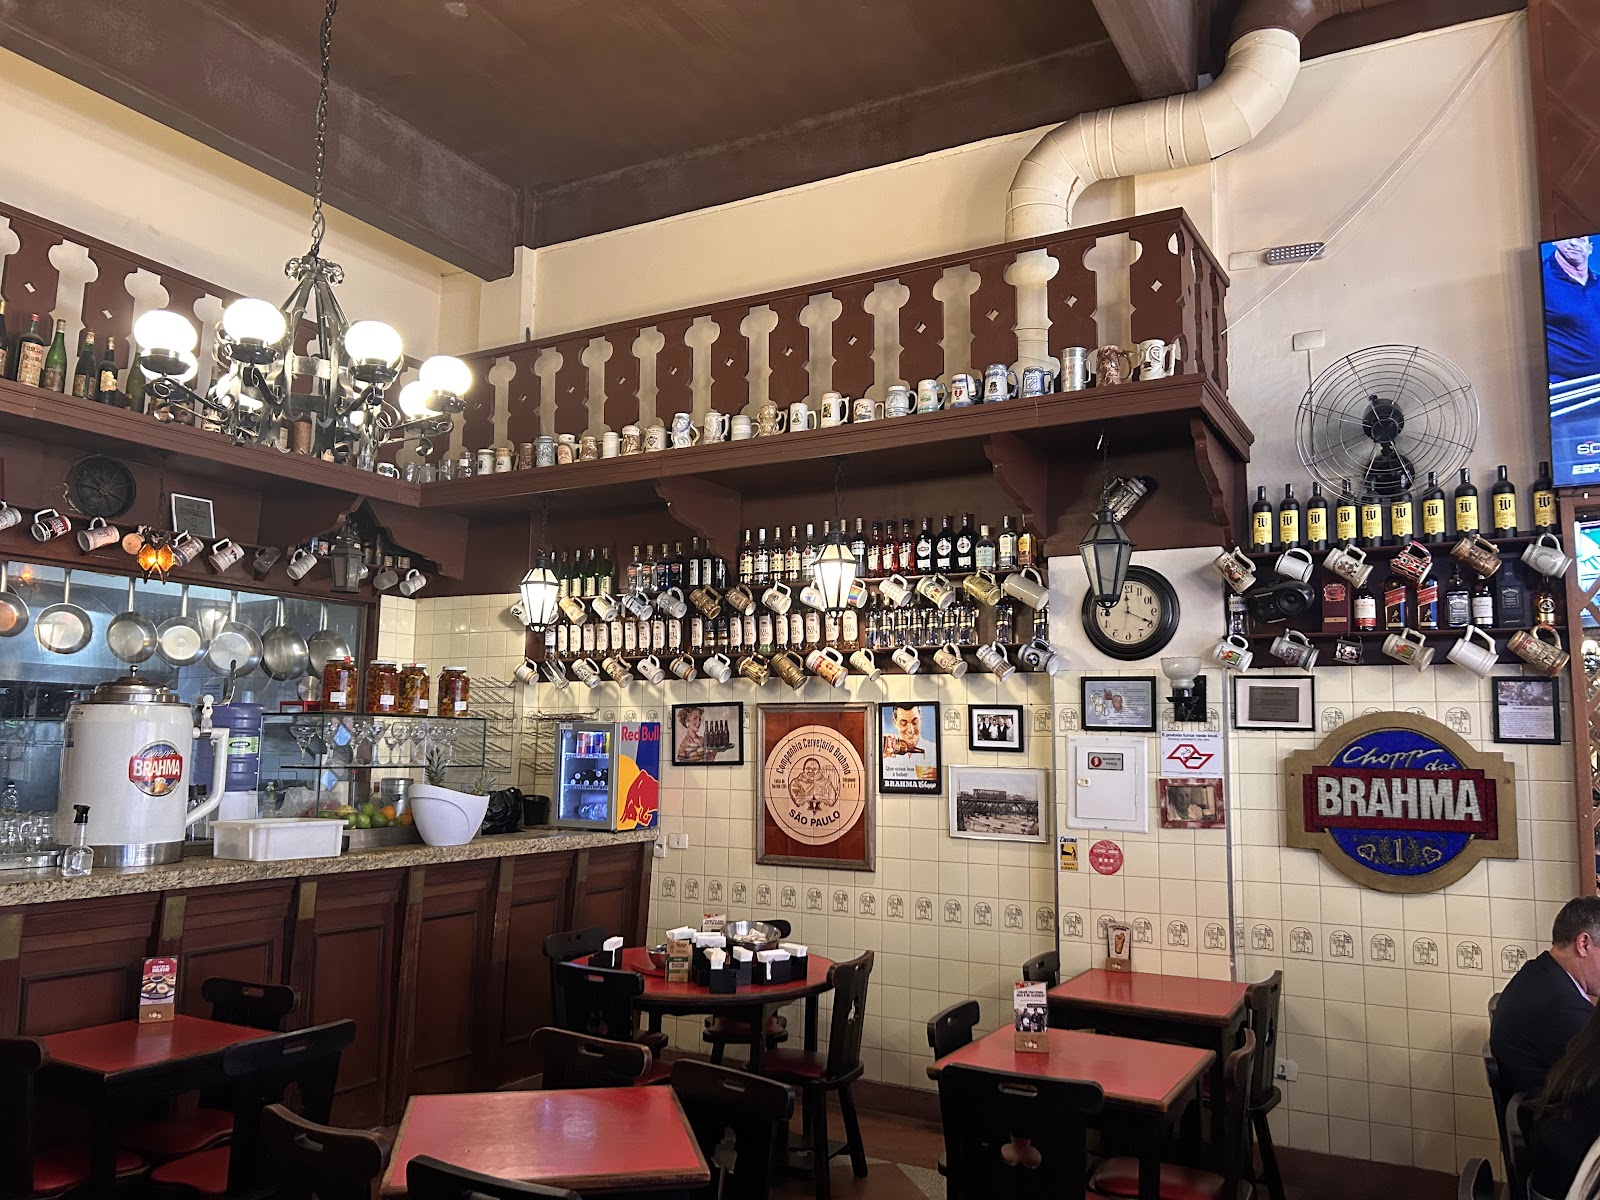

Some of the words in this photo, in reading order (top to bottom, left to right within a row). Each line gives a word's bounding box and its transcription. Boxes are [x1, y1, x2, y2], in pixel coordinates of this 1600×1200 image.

[1572, 463, 1600, 474] ESP
[622, 725, 640, 741] Red
[642, 726, 660, 741] Bull
[776, 741, 803, 774] Companhia
[803, 738, 835, 752] Cervejaria
[833, 747, 851, 775] Brahma
[1343, 746, 1444, 769] Chopp
[133, 759, 180, 777] BRAHMA
[884, 780, 918, 788] BRAHMA
[1317, 776, 1482, 822] BRAHMA
[789, 809, 808, 825] SÃO
[810, 810, 840, 827] PAULO
